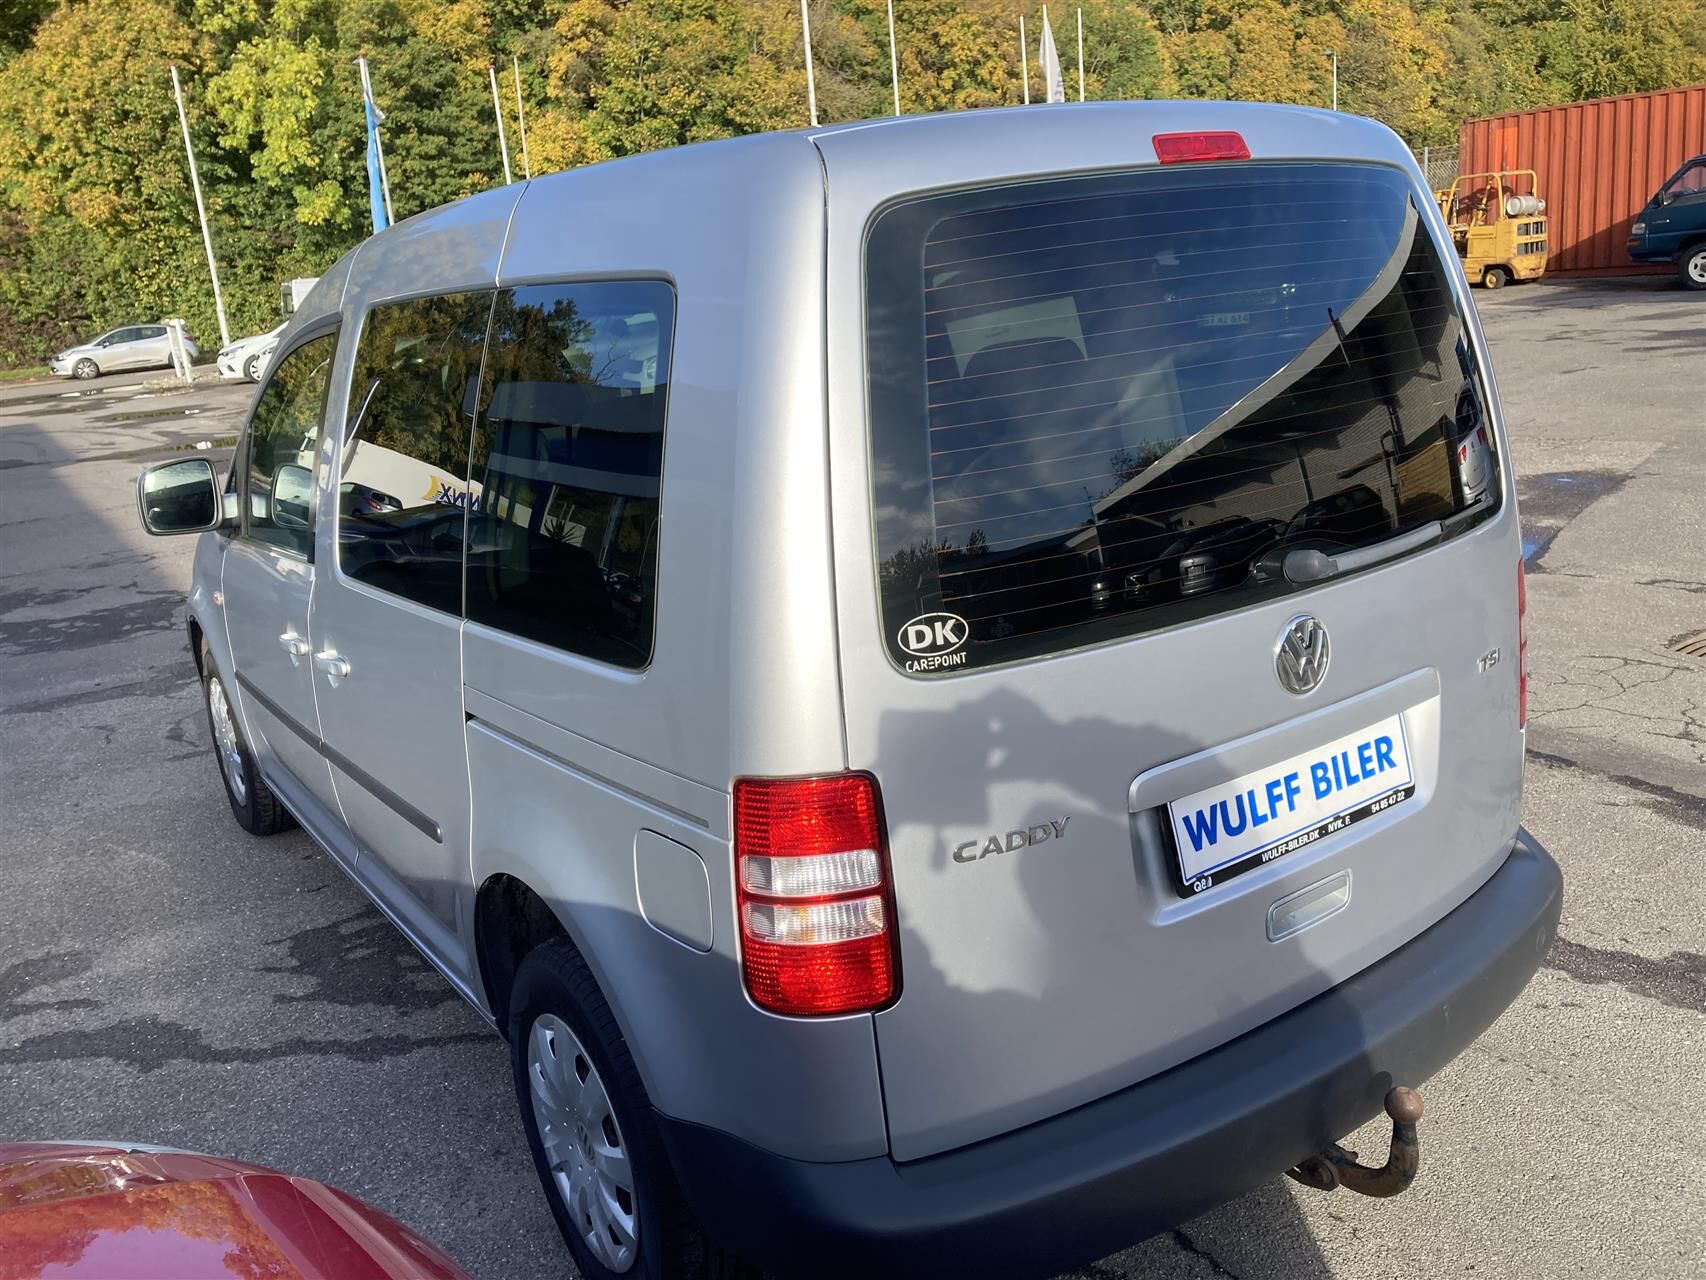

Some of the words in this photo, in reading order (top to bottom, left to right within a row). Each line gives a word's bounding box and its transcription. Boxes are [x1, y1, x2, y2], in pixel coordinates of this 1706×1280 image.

[907, 619, 959, 650] DK
[905, 651, 967, 673] CAREPOINT
[1476, 647, 1500, 673] TSI
[1182, 771, 1301, 852] WULFF
[1310, 735, 1397, 800] BILER
[953, 816, 1071, 863] CADDY
[1261, 829, 1320, 863] WULFF-BILER.DK
[1371, 802, 1380, 813] 54
[1389, 794, 1397, 805] 47
[1397, 791, 1405, 802] 22
